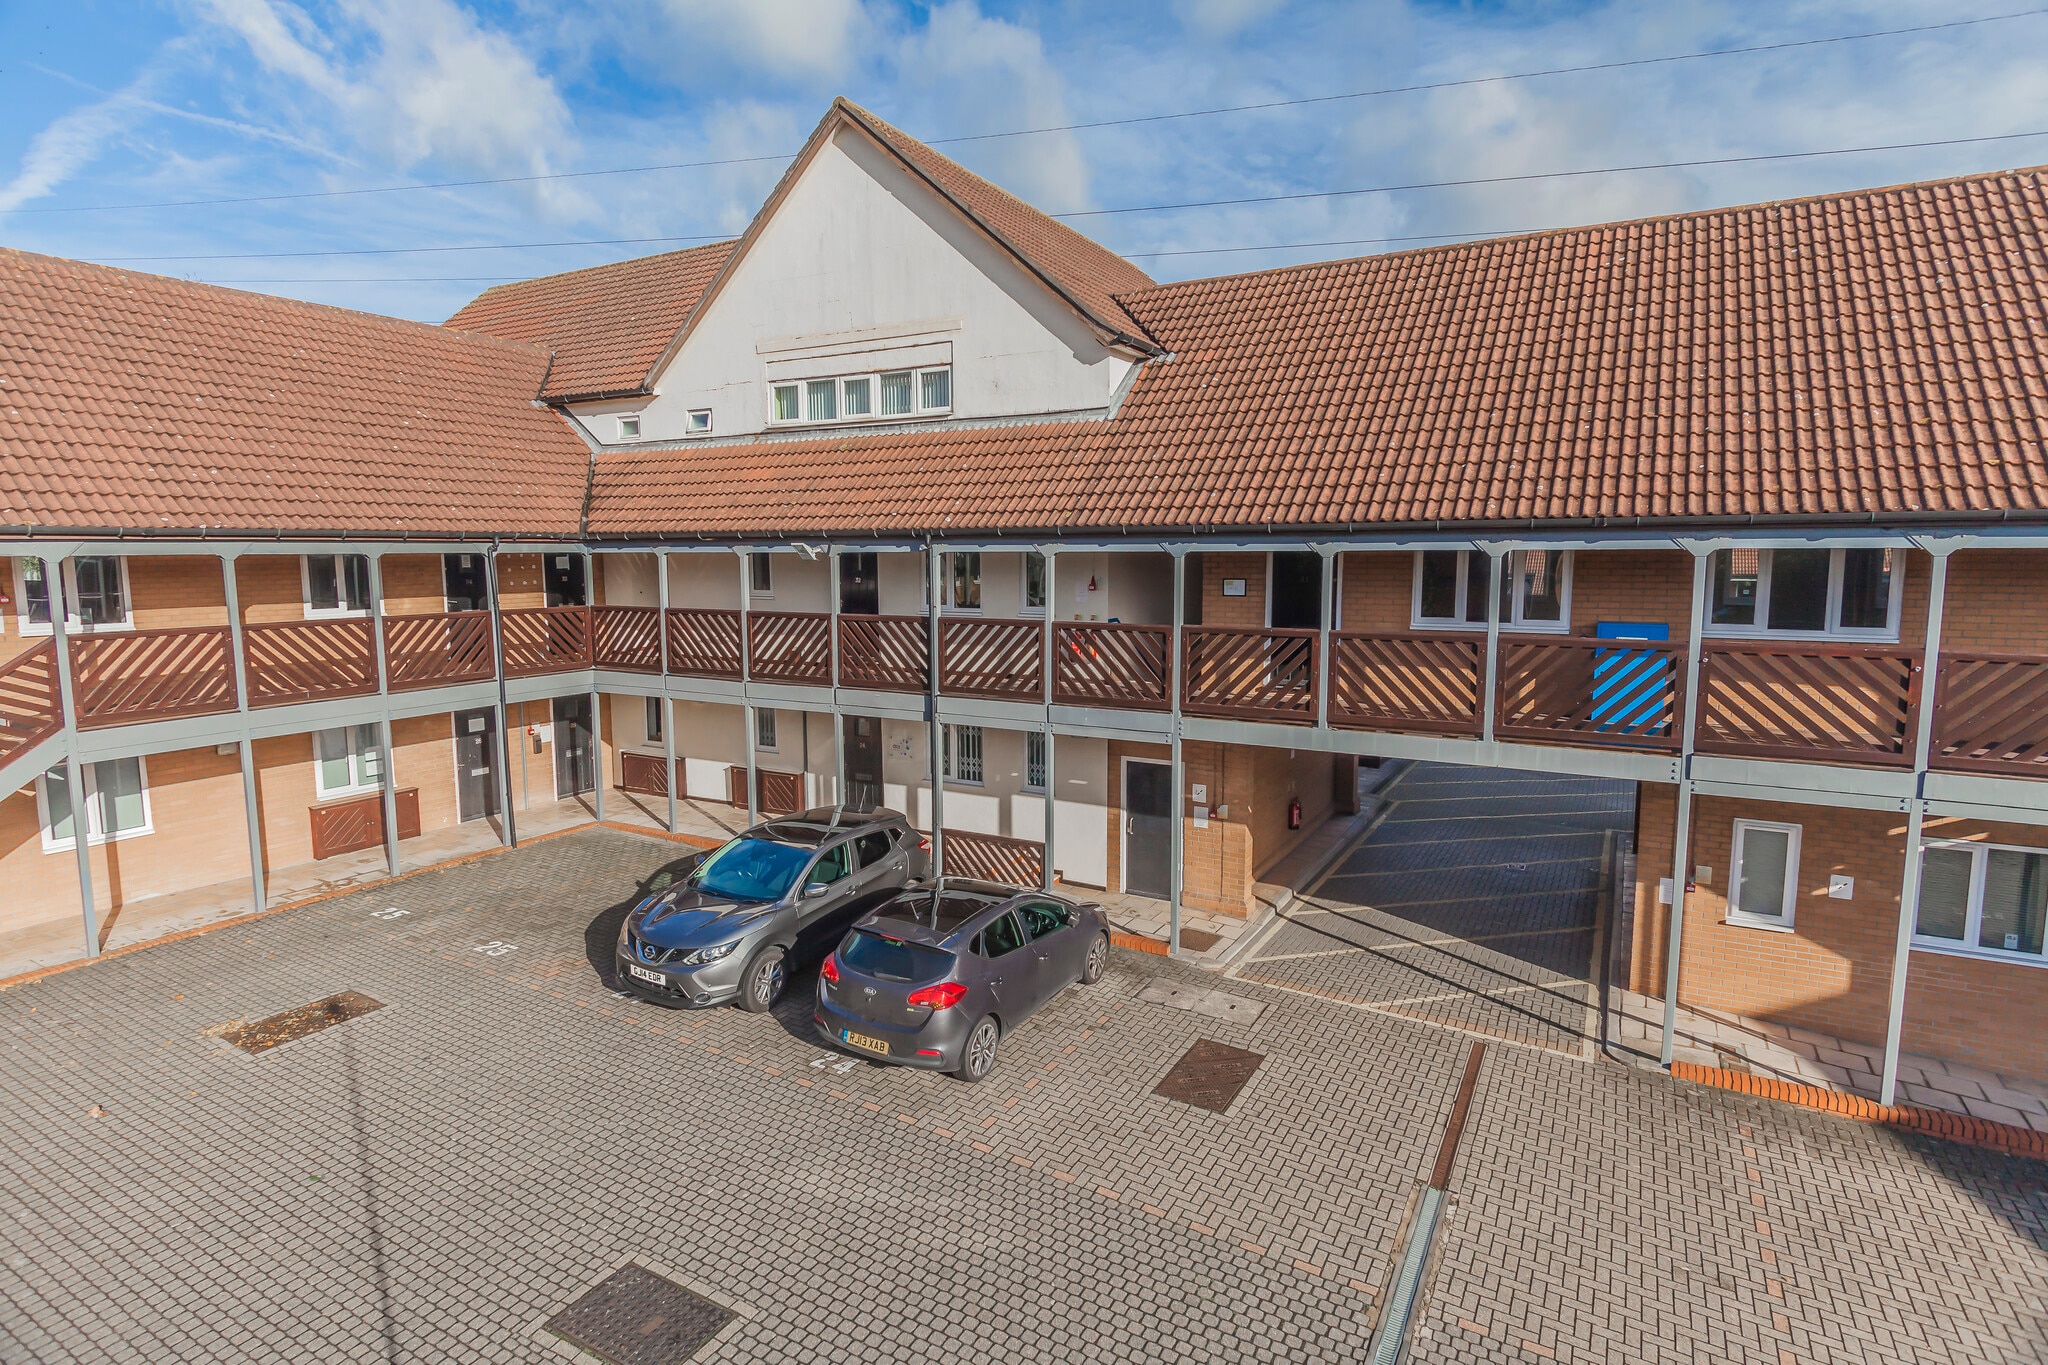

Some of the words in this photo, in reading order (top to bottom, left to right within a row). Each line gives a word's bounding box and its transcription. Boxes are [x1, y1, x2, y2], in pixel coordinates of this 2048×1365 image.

[473, 941, 519, 956] 25
[633, 966, 648, 979] GJ14
[648, 972, 661, 983] EDR
[849, 1031, 868, 1047] RJ13
[868, 1037, 886, 1052] XAB
[810, 1051, 860, 1075] 24
